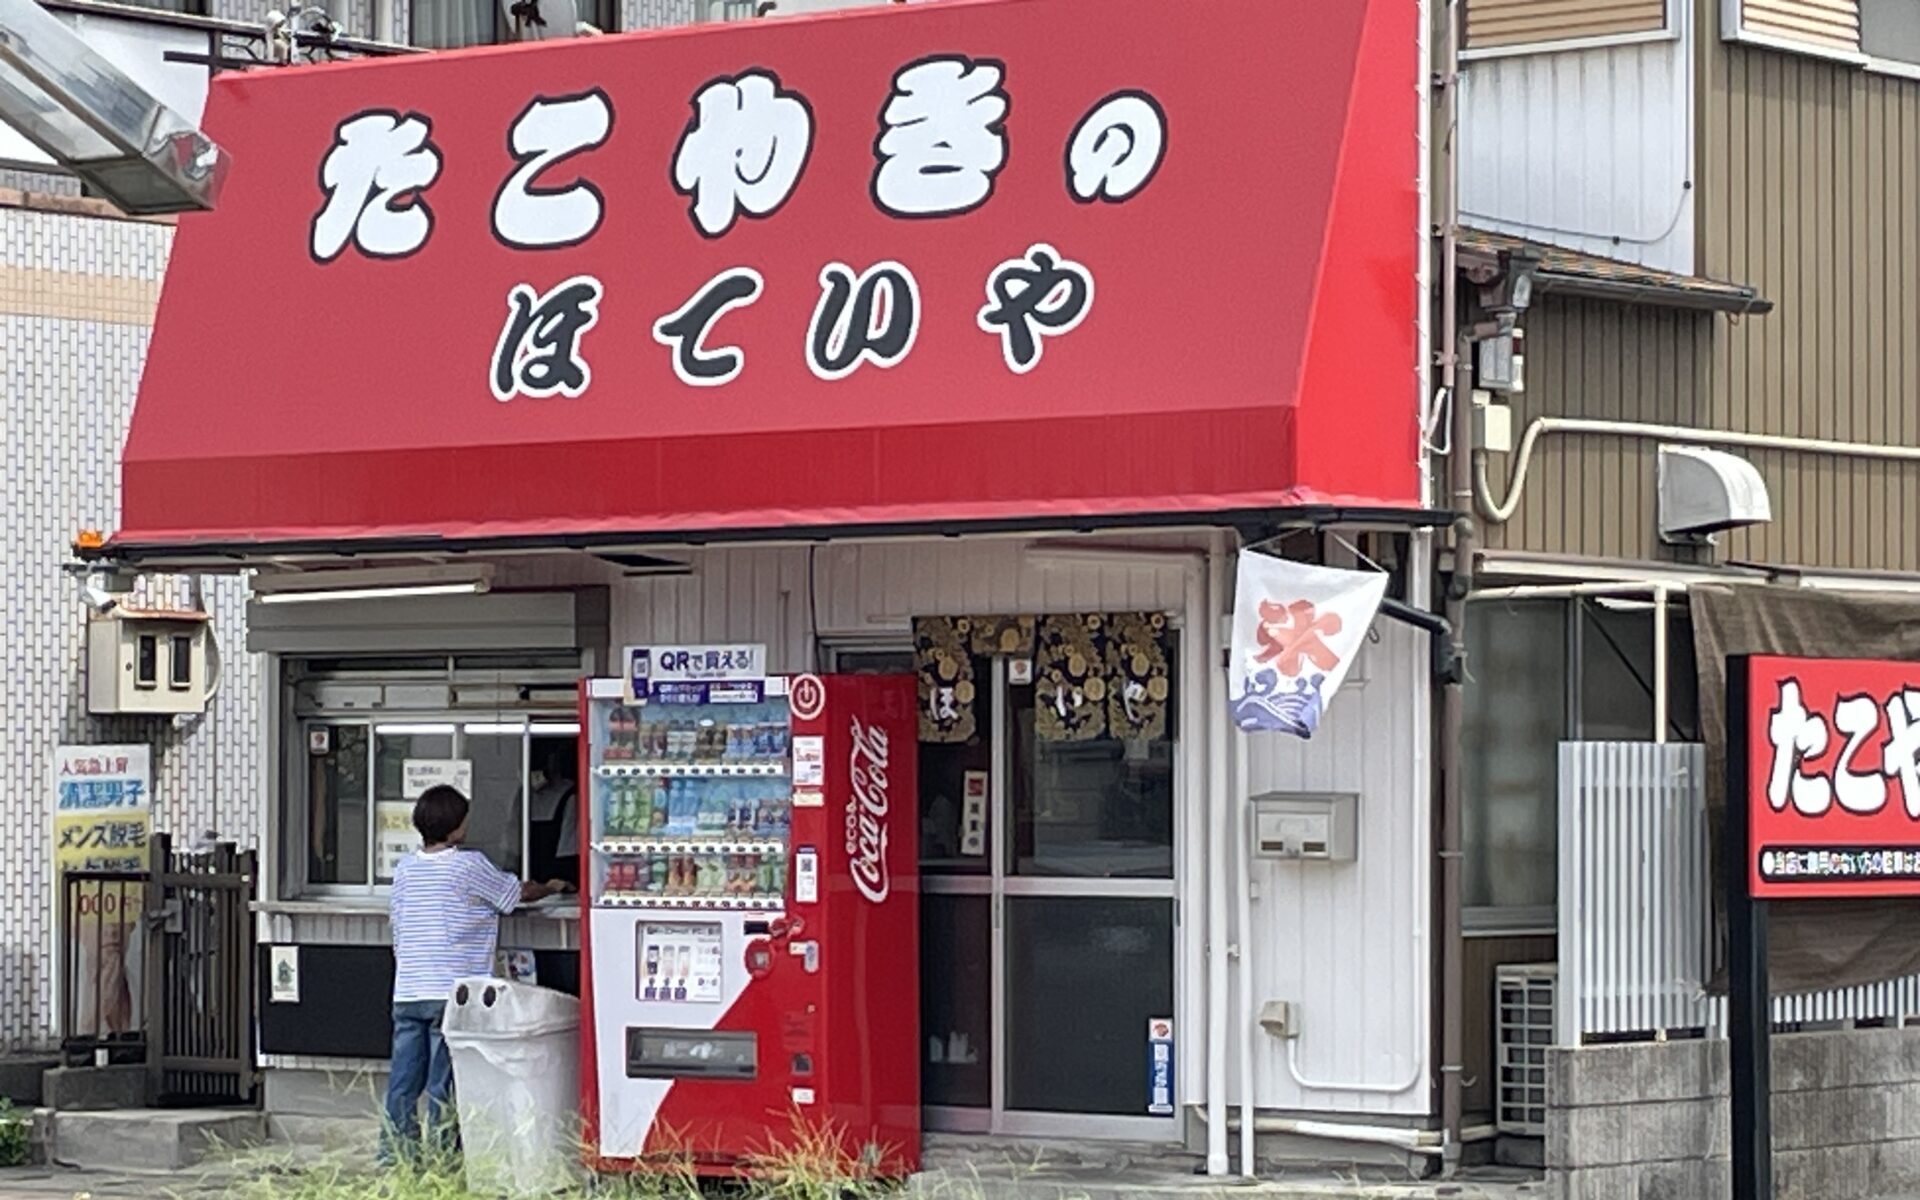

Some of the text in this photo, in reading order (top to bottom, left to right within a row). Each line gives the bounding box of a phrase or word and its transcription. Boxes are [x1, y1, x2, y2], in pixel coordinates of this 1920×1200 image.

[309, 54, 1168, 263] たこやきの
[490, 242, 1094, 401] ほていや
[58, 821, 146, 849] メンズ脱毛
[850, 714, 889, 903] Coca-Cola
